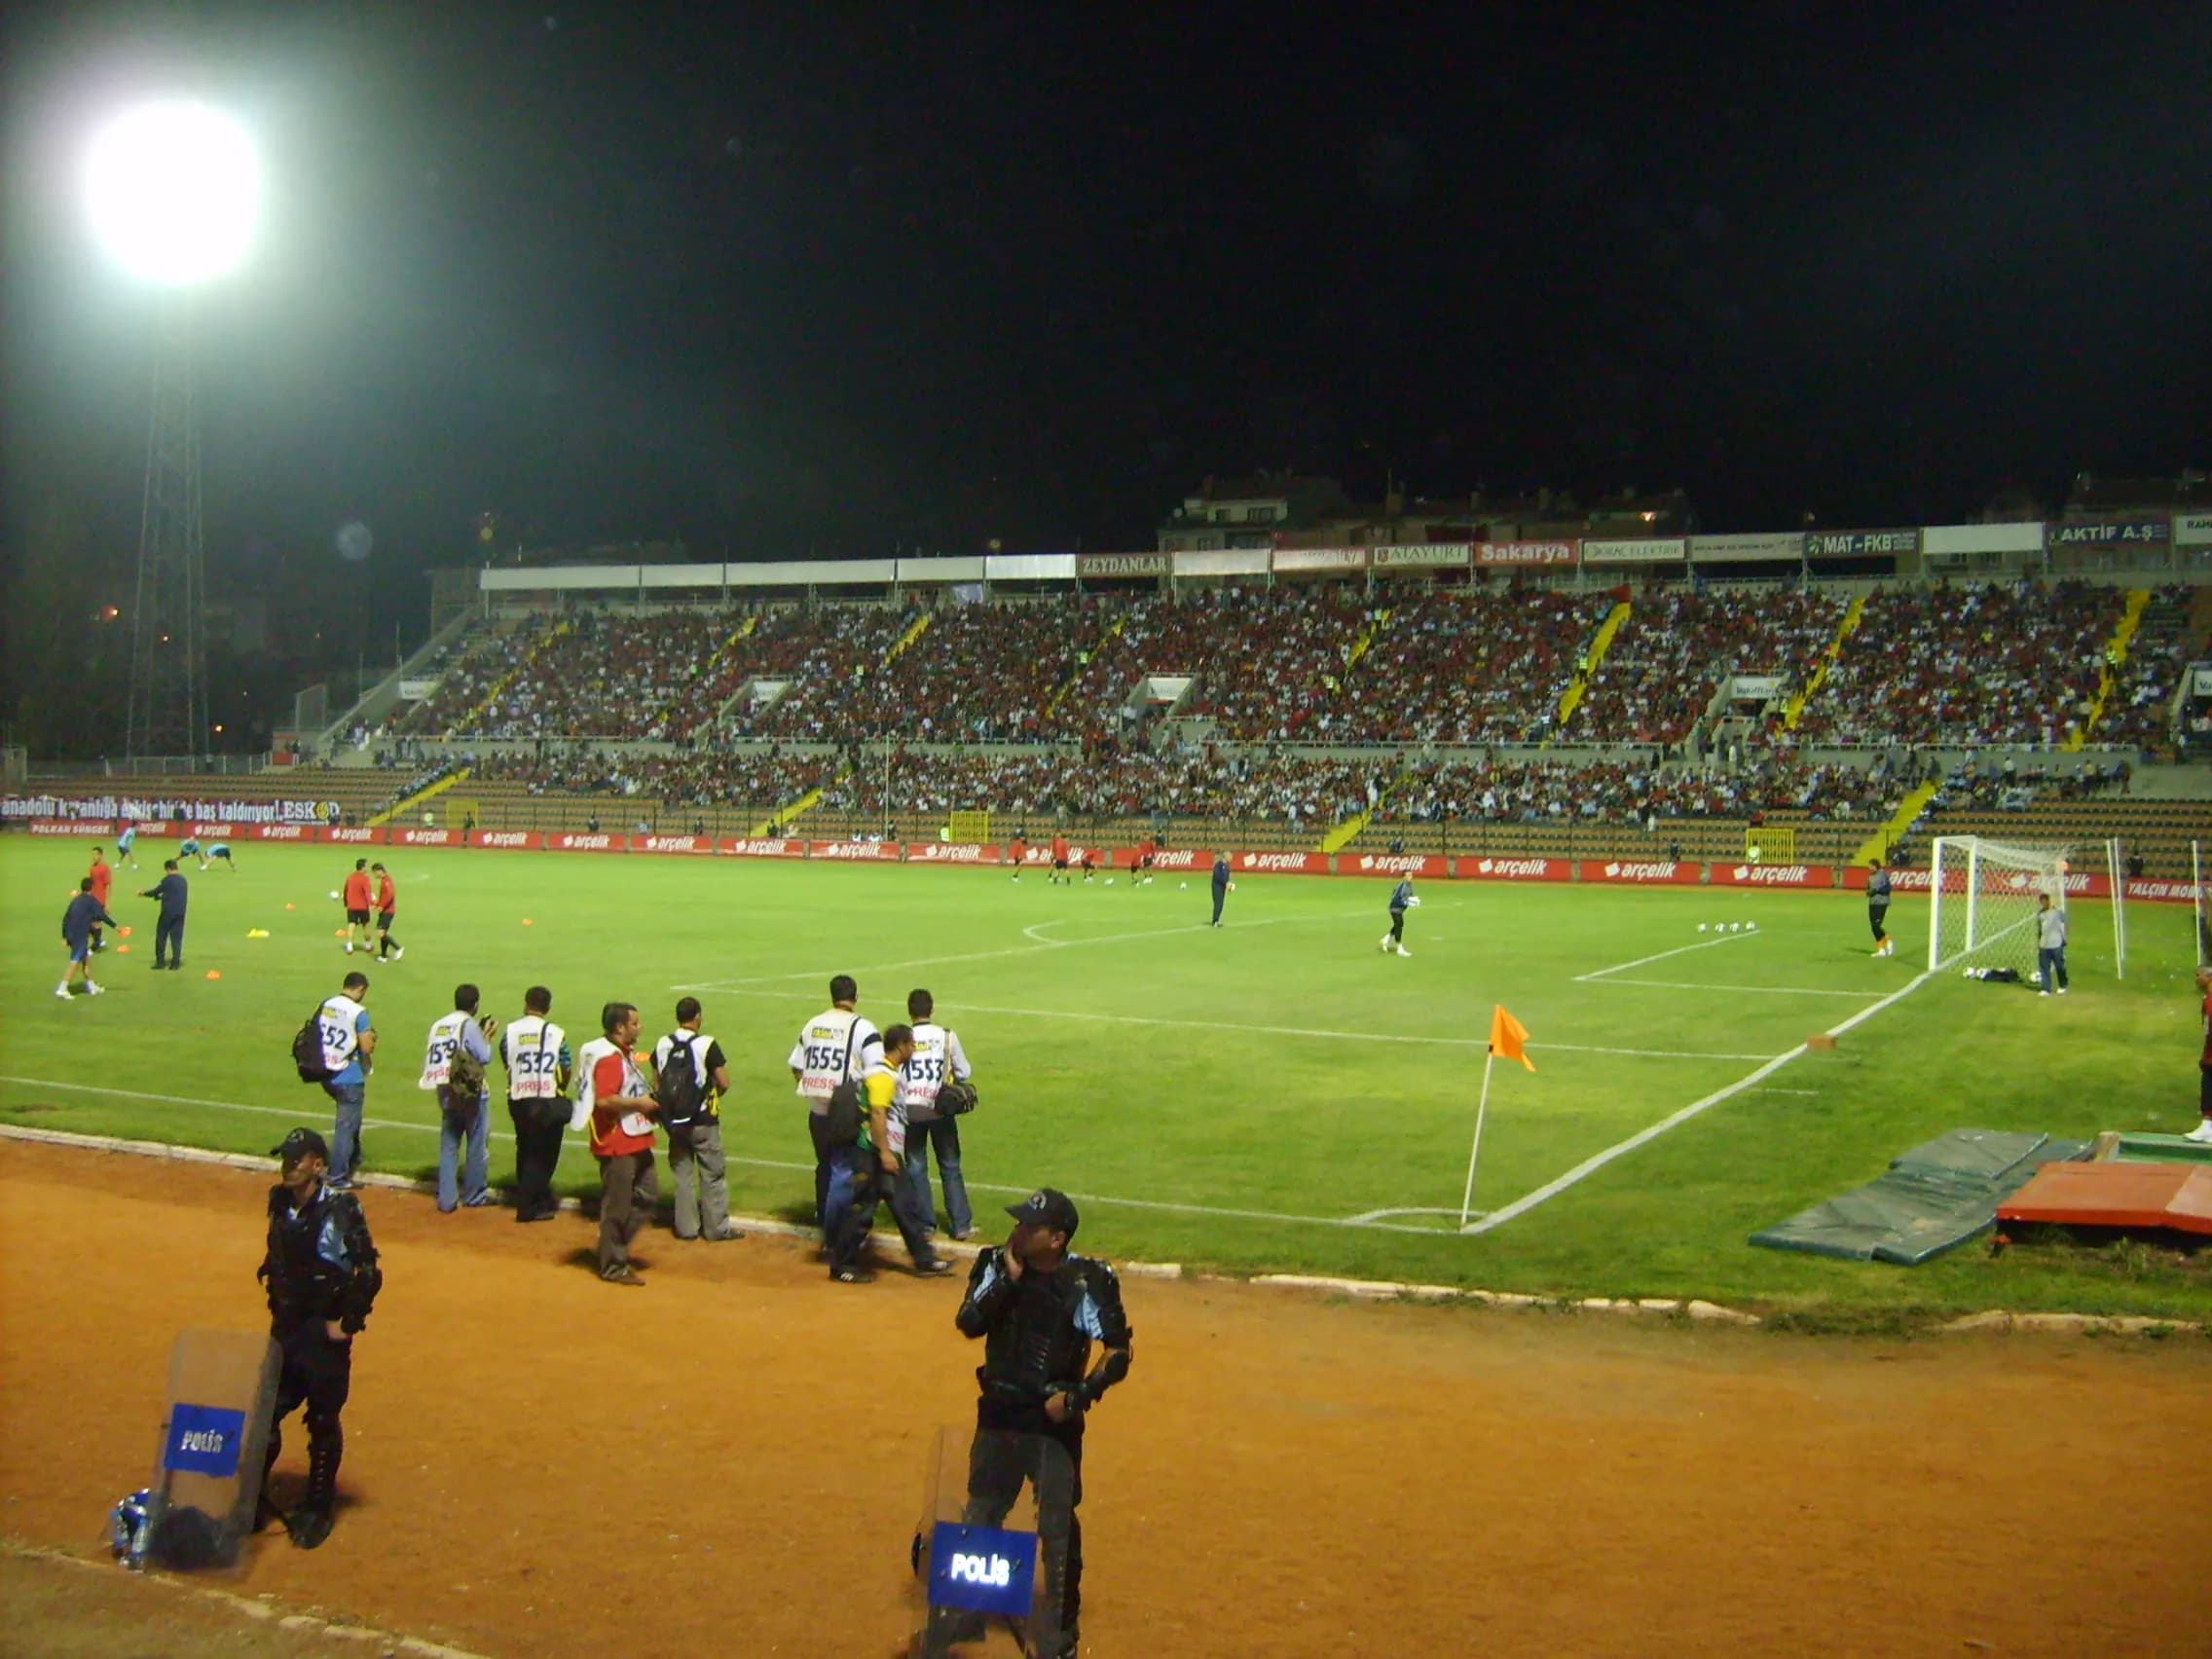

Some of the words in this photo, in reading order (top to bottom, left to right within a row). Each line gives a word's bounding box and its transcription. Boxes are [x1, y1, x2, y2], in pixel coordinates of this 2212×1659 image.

[2061, 523, 2118, 540] AKTİF
[1482, 543, 1569, 564] Sakarya
[1083, 556, 1166, 572] ZEYDANLAR
[1, 797, 55, 816] anadolu
[197, 799, 216, 822] baş
[203, 826, 232, 837] arçelik
[272, 828, 301, 838] arçelik
[342, 829, 373, 841] arçelik
[416, 830, 448, 844] arçelik
[494, 832, 528, 847] arçelik
[574, 834, 610, 849] arçelik
[658, 836, 695, 852] arçelik
[748, 839, 787, 855] arçelik
[839, 841, 881, 859] arçelik
[939, 844, 981, 861] arçelik
[1257, 854, 1307, 871] arçelik
[1375, 856, 1426, 873] arçelik
[1494, 859, 1547, 876] arçelik
[1621, 863, 1677, 881] arçelik
[1750, 866, 1808, 885] arçelik
[2128, 882, 2169, 899] YALÇIN
[516, 1051, 555, 1075] 1532
[804, 1045, 844, 1072] 1555
[902, 1057, 944, 1083] 1553
